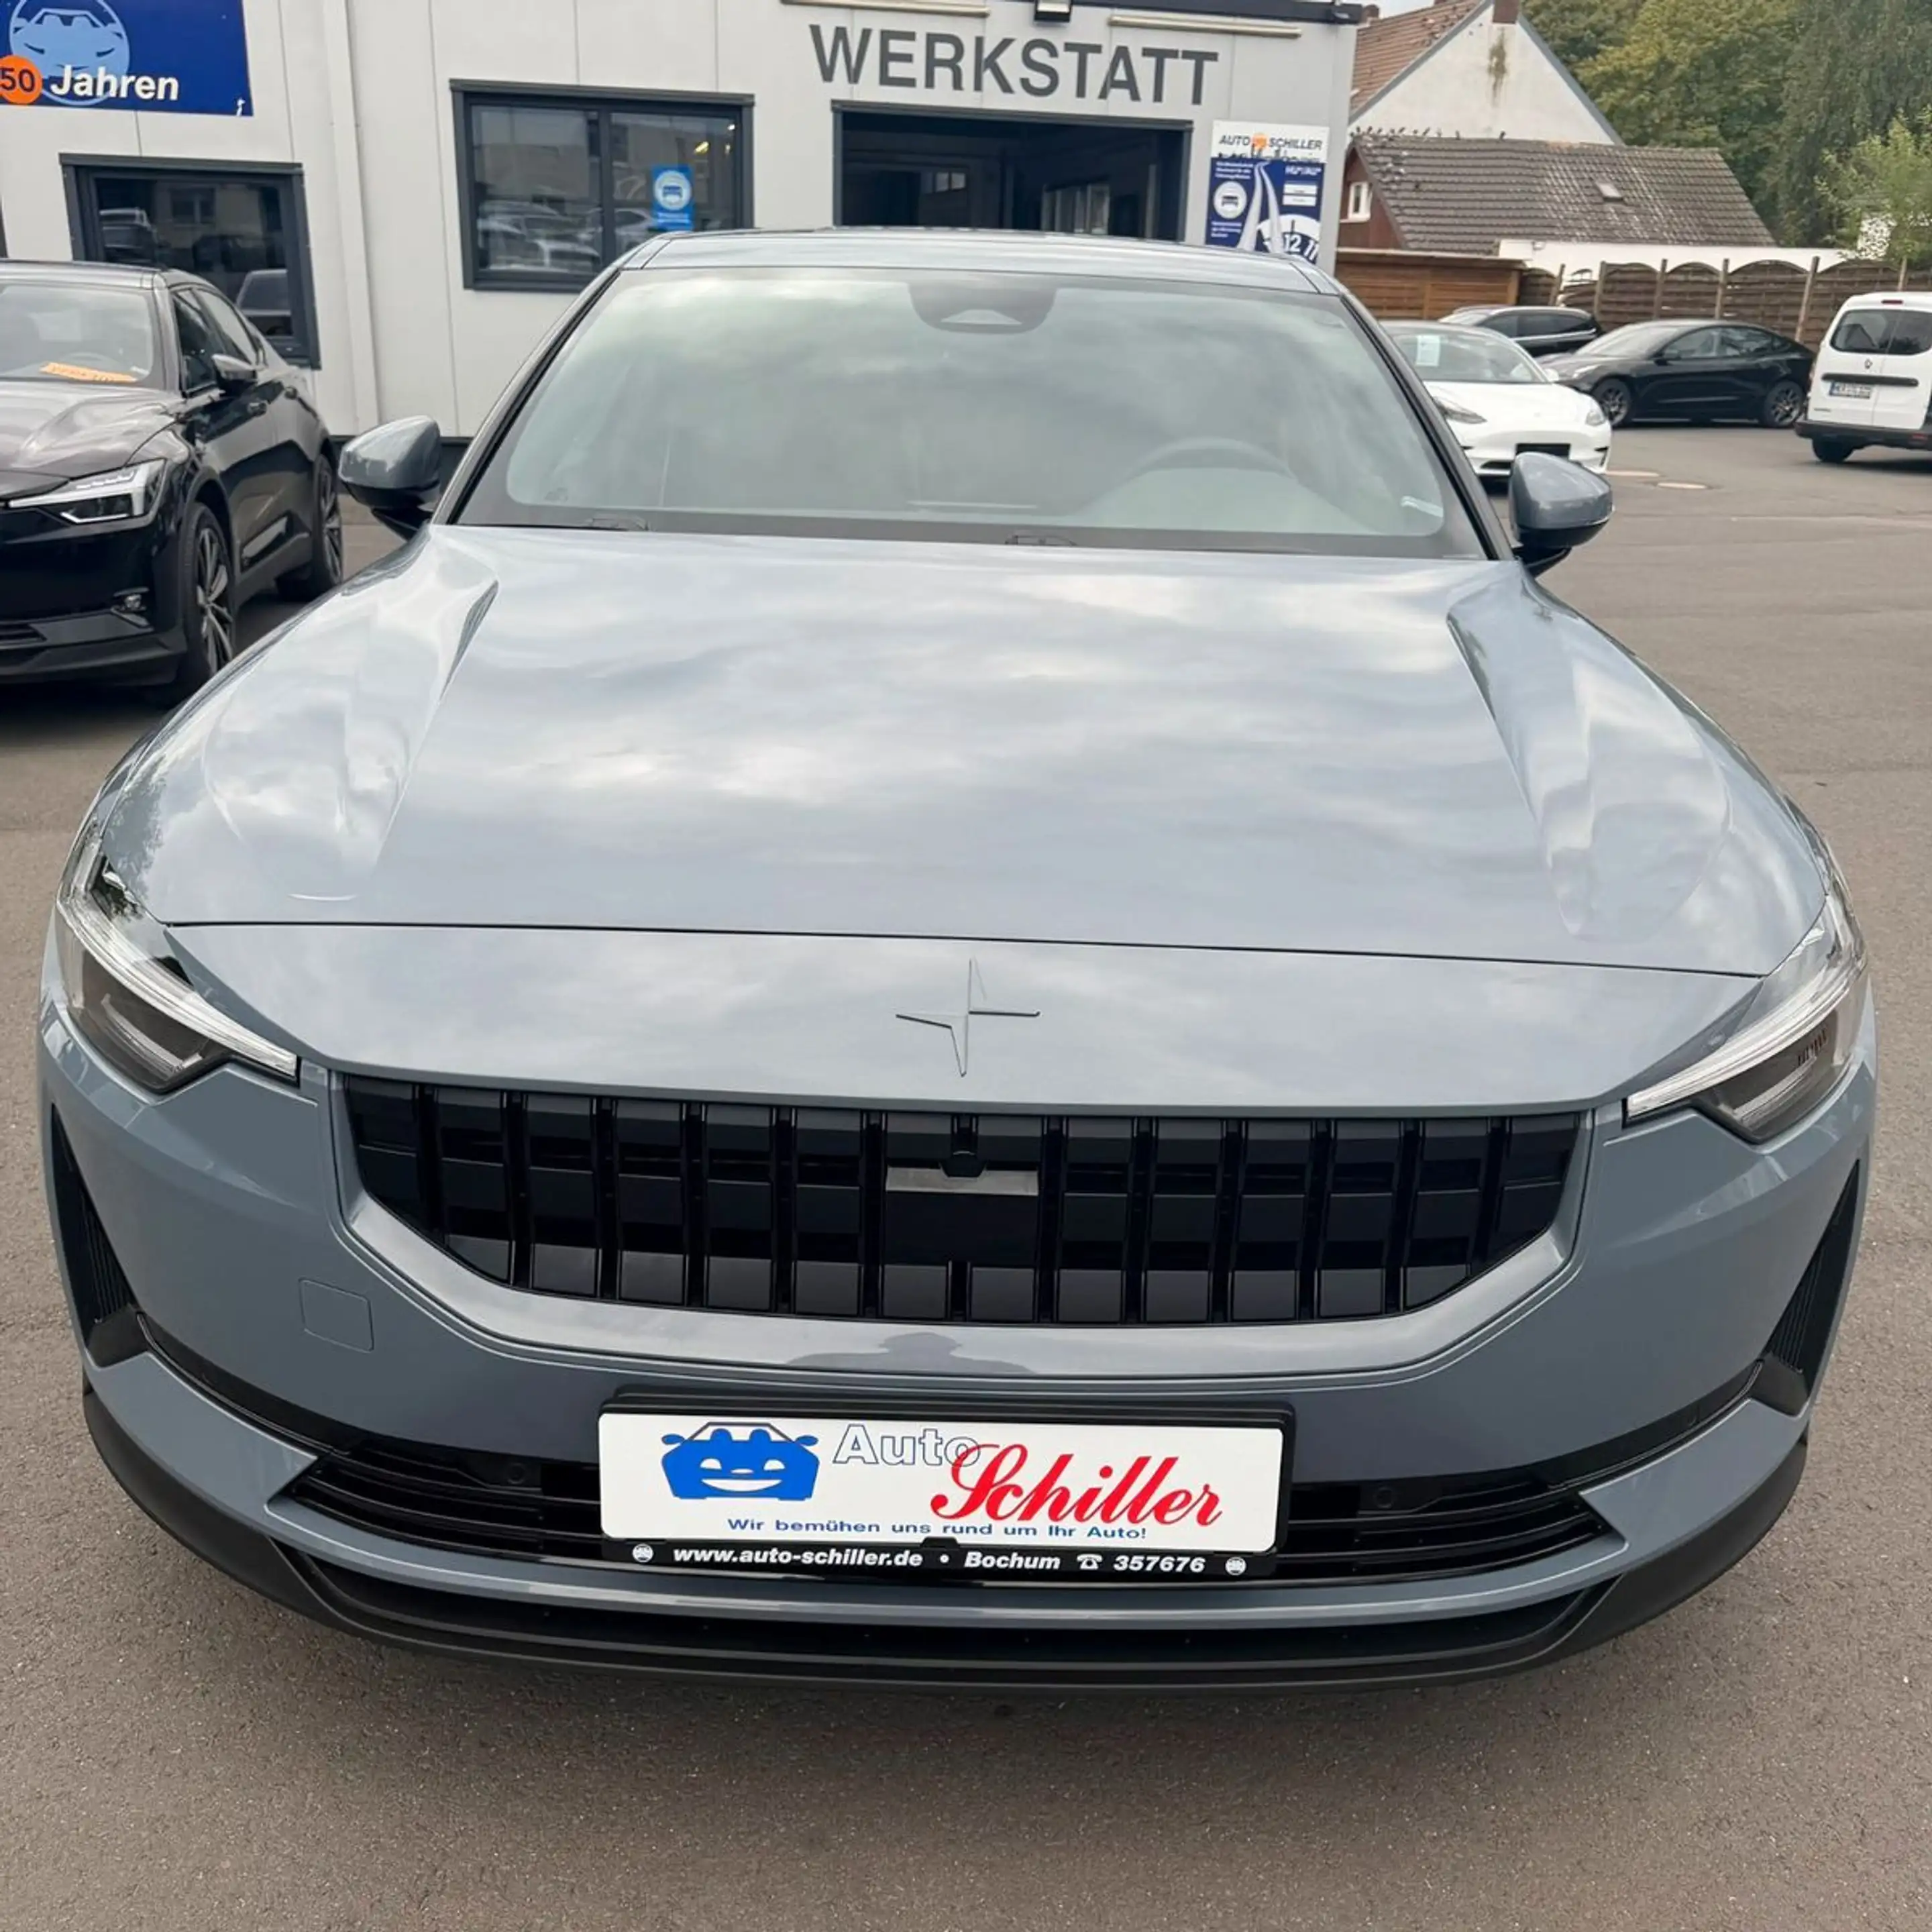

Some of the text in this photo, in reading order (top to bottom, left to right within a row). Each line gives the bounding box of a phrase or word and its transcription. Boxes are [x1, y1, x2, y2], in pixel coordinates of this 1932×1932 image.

[809, 24, 1219, 106] WERKSTATT
[0, 64, 179, 101] 50 Jahren
[1219, 135, 1323, 150] AUTO SCHILLER
[1284, 233, 1301, 252] 12
[833, 1424, 1223, 1527] Auto Schiller
[729, 1518, 1147, 1540] Wir bemühen uns rund um Ihr Auto!
[673, 1546, 1206, 1573] www.auto-schiller.de Bochum 357676
